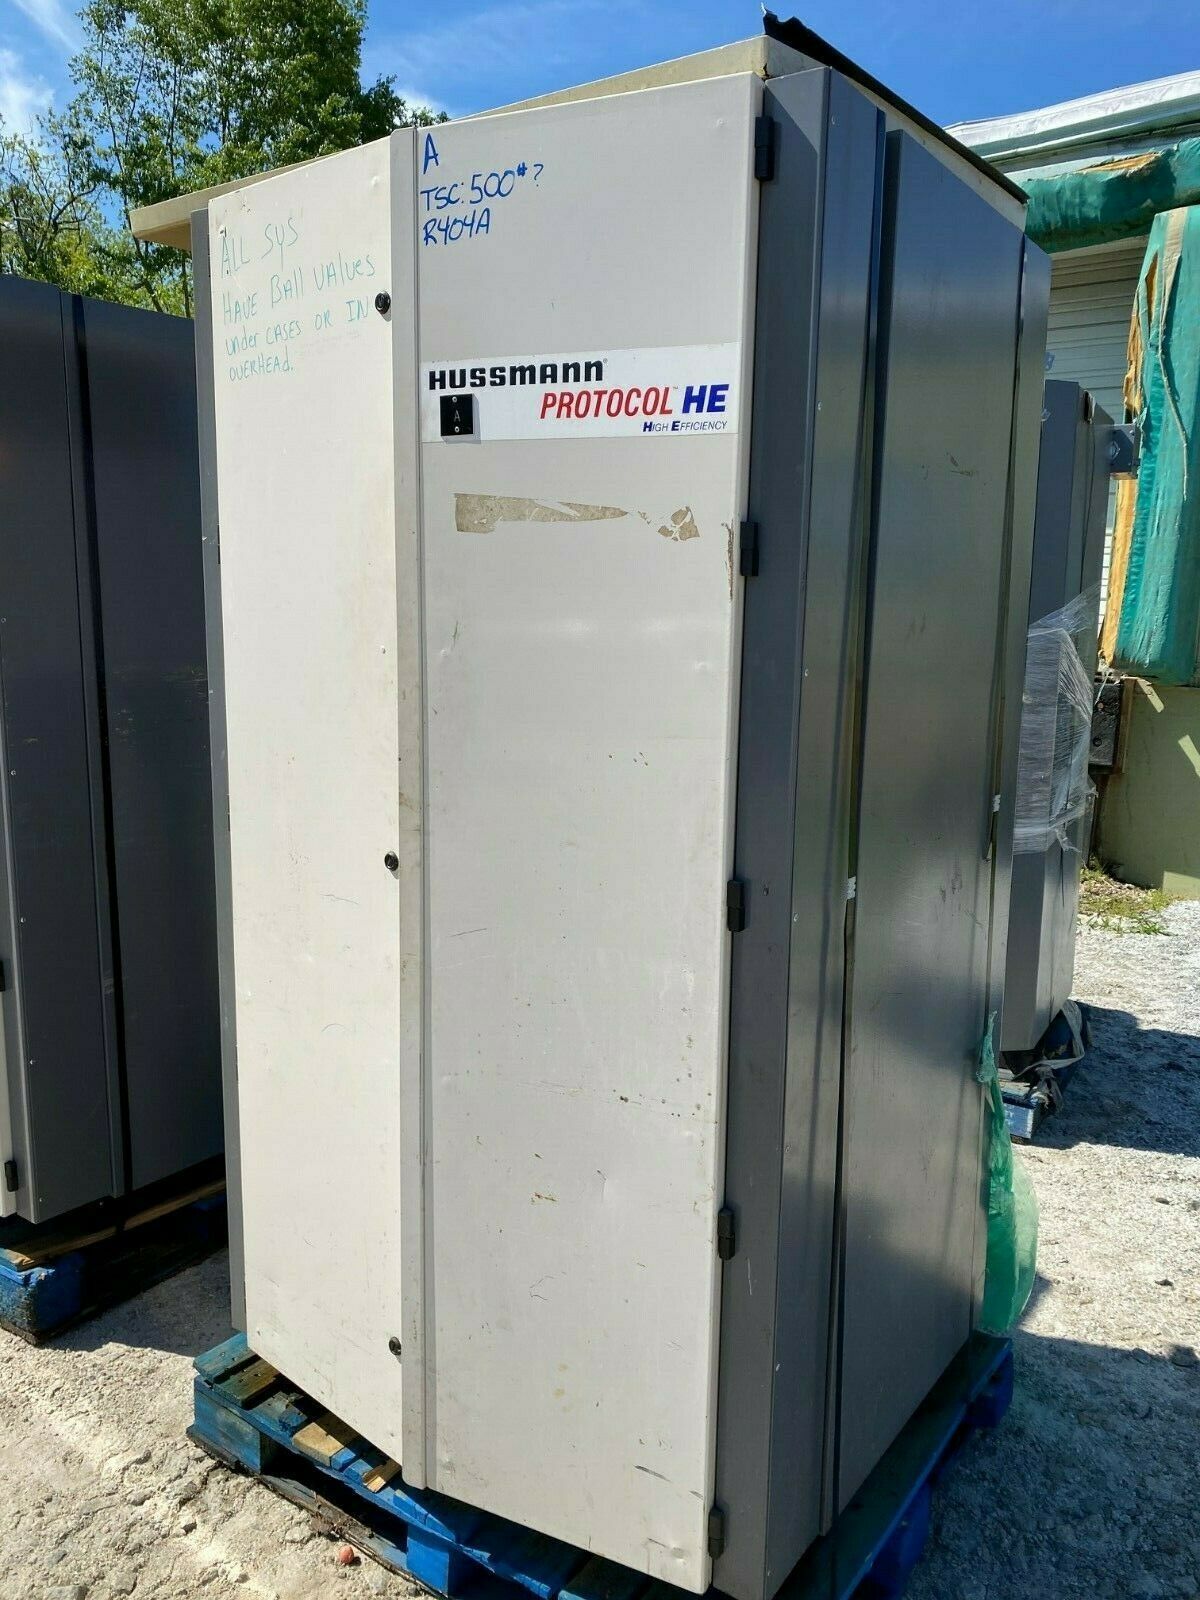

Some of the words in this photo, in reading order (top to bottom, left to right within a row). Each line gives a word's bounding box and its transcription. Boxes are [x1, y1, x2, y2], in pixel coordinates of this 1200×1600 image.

[423, 133, 439, 175] A
[423, 207, 491, 246] R404A
[221, 236, 250, 279] ALL
[261, 217, 299, 272] SYS
[222, 290, 258, 325] HAVE
[266, 320, 302, 345] CASES
[314, 309, 333, 331] OR
[345, 296, 369, 322] IN
[453, 409, 461, 422] A
[540, 386, 673, 419] PROTOCOL
[682, 383, 730, 414] HE
[643, 421, 669, 433] HIGH
[671, 420, 728, 432] EFFICIENCY
